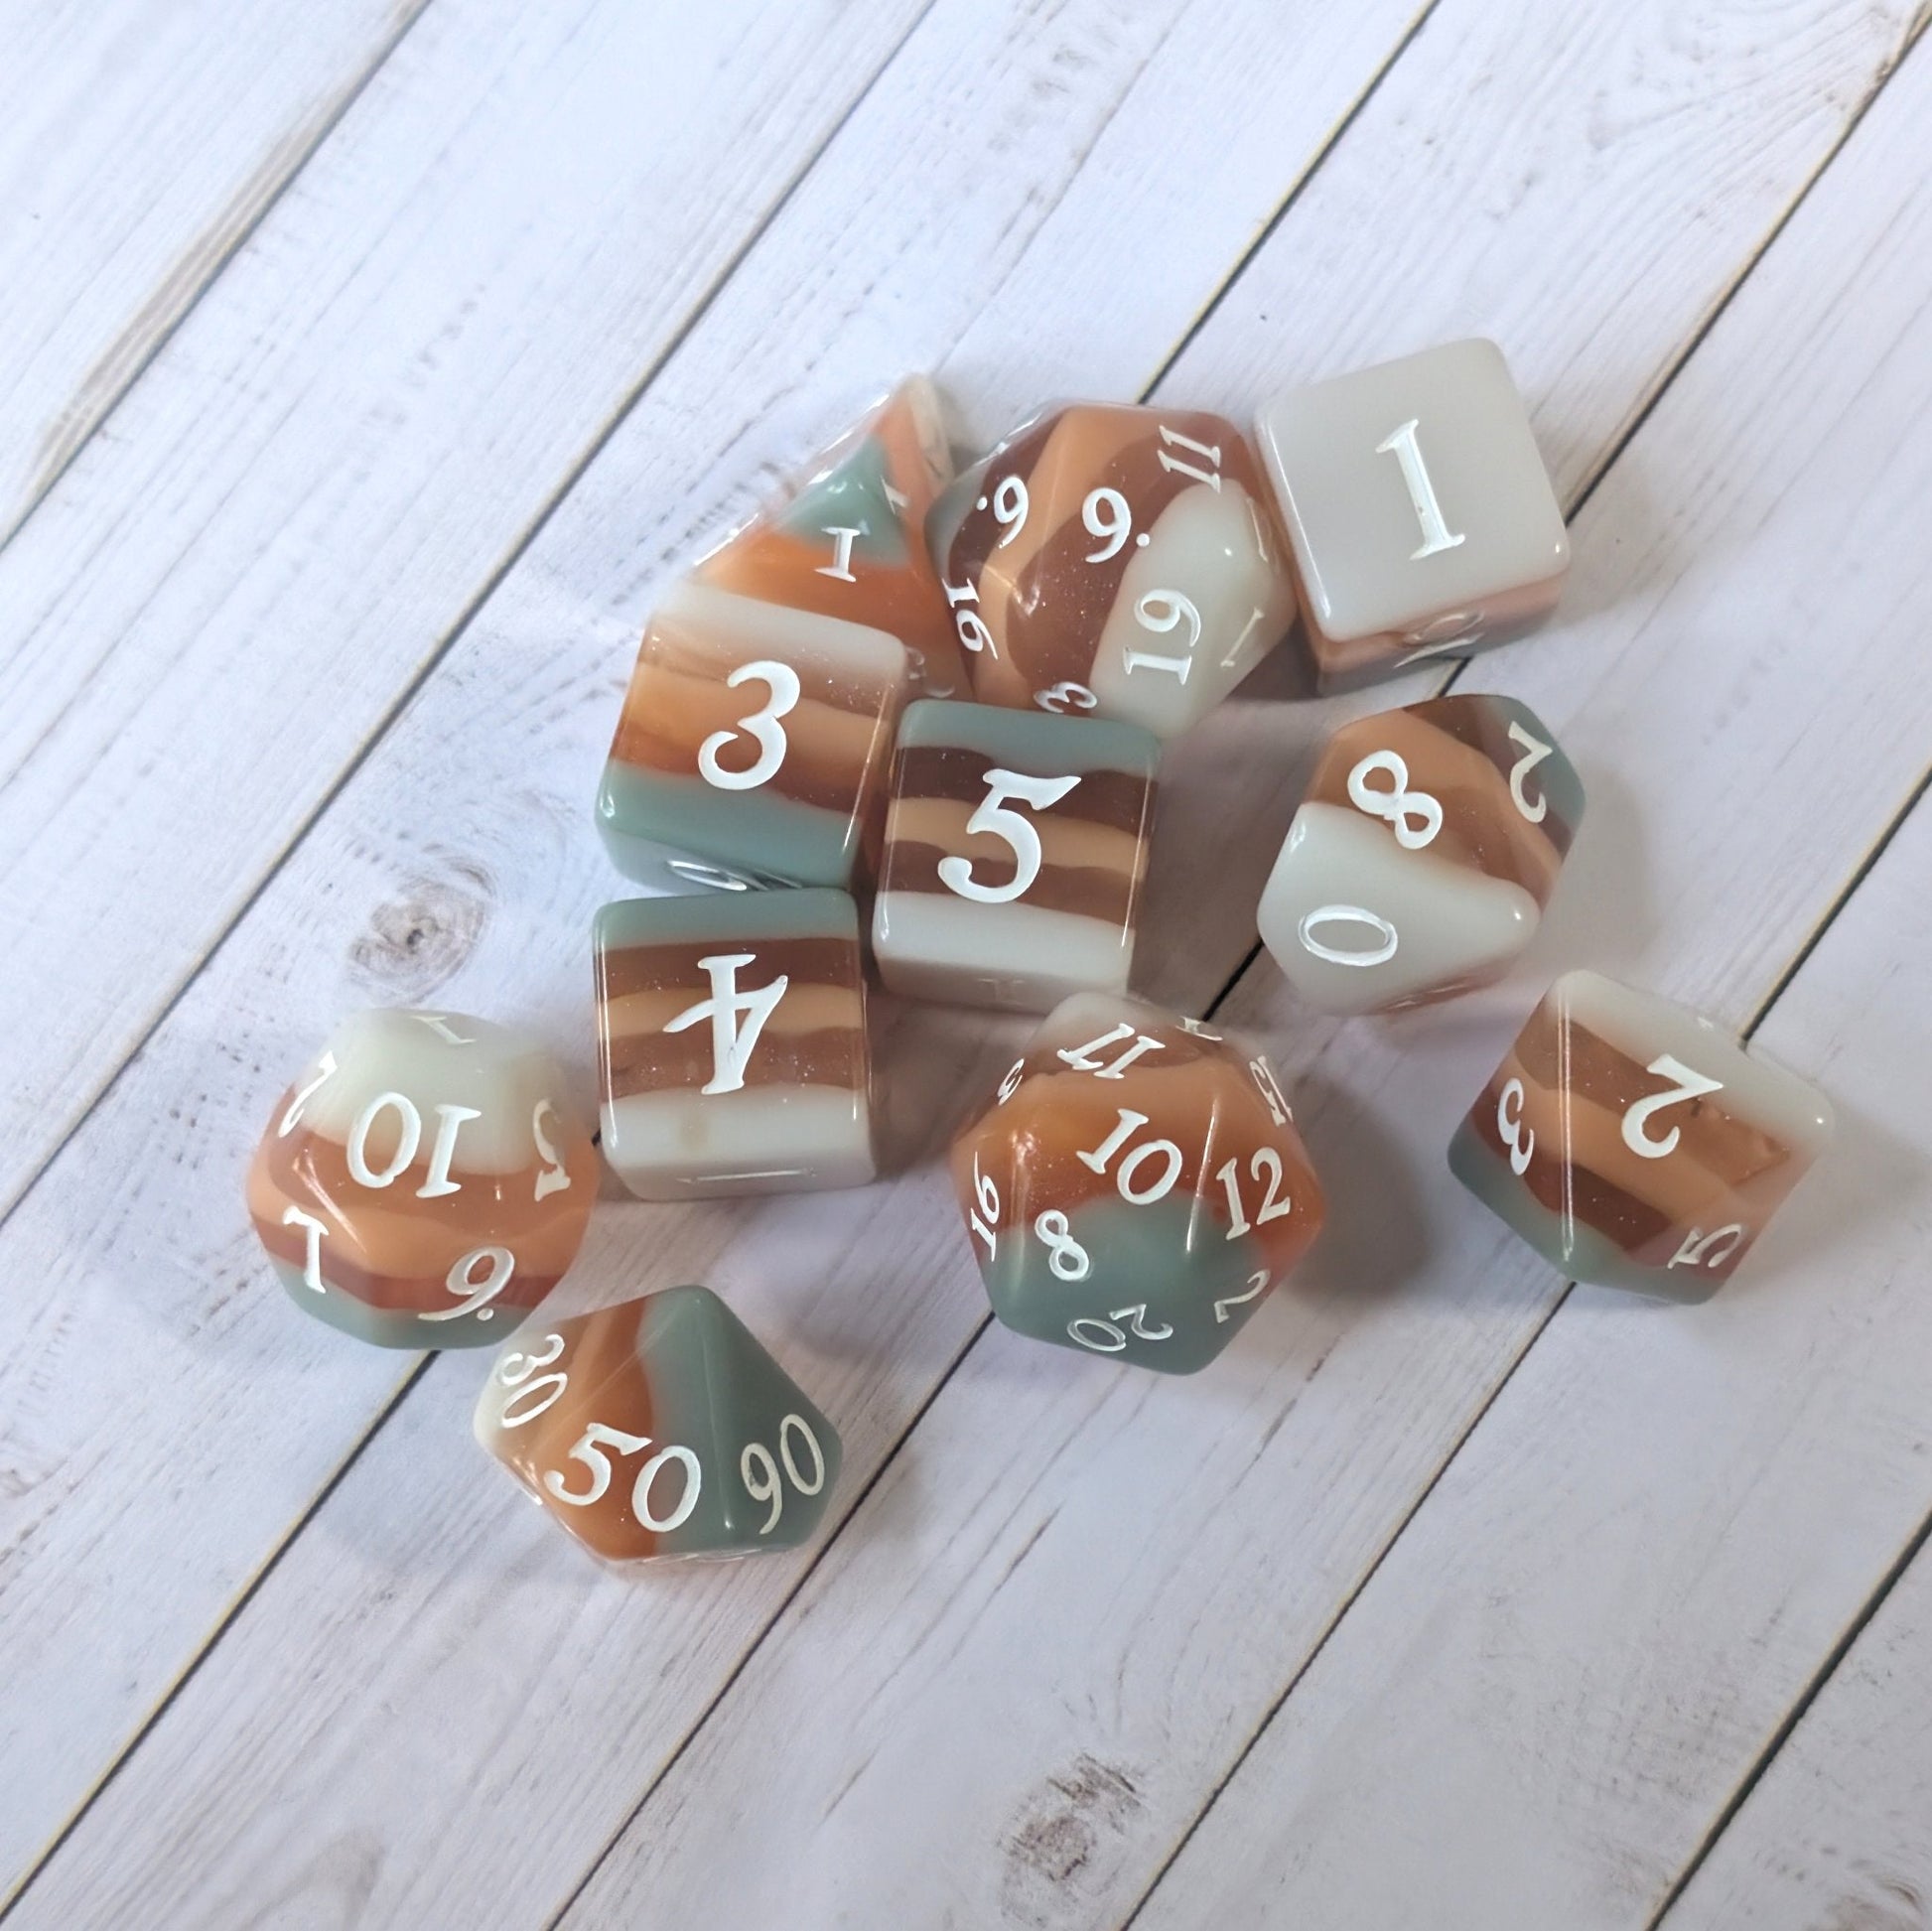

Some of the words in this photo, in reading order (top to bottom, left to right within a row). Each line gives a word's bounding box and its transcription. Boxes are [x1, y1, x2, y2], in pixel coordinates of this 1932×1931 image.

[1158, 425, 1221, 493] 11
[1375, 418, 1465, 561] 1
[815, 526, 861, 583] 1
[1123, 589, 1201, 685] 19
[698, 659, 800, 790] 3
[1508, 721, 1553, 823] 2
[937, 768, 1082, 903] 5
[1347, 750, 1444, 850] 8
[1298, 904, 1399, 967] 0
[662, 953, 788, 1095] 4
[1497, 1077, 1535, 1175] 3
[1621, 1053, 1724, 1159] 2
[1075, 1108, 1183, 1205] 10
[1215, 1147, 1292, 1241] 12
[970, 1151, 1001, 1262] 16
[1034, 1209, 1090, 1282] 8
[1666, 1223, 1742, 1270] 5
[1066, 1304, 1174, 1352] 20
[1213, 1270, 1271, 1323] 2
[495, 1333, 569, 1429] 30
[543, 1422, 702, 1533] 50
[740, 1414, 826, 1535] 90
